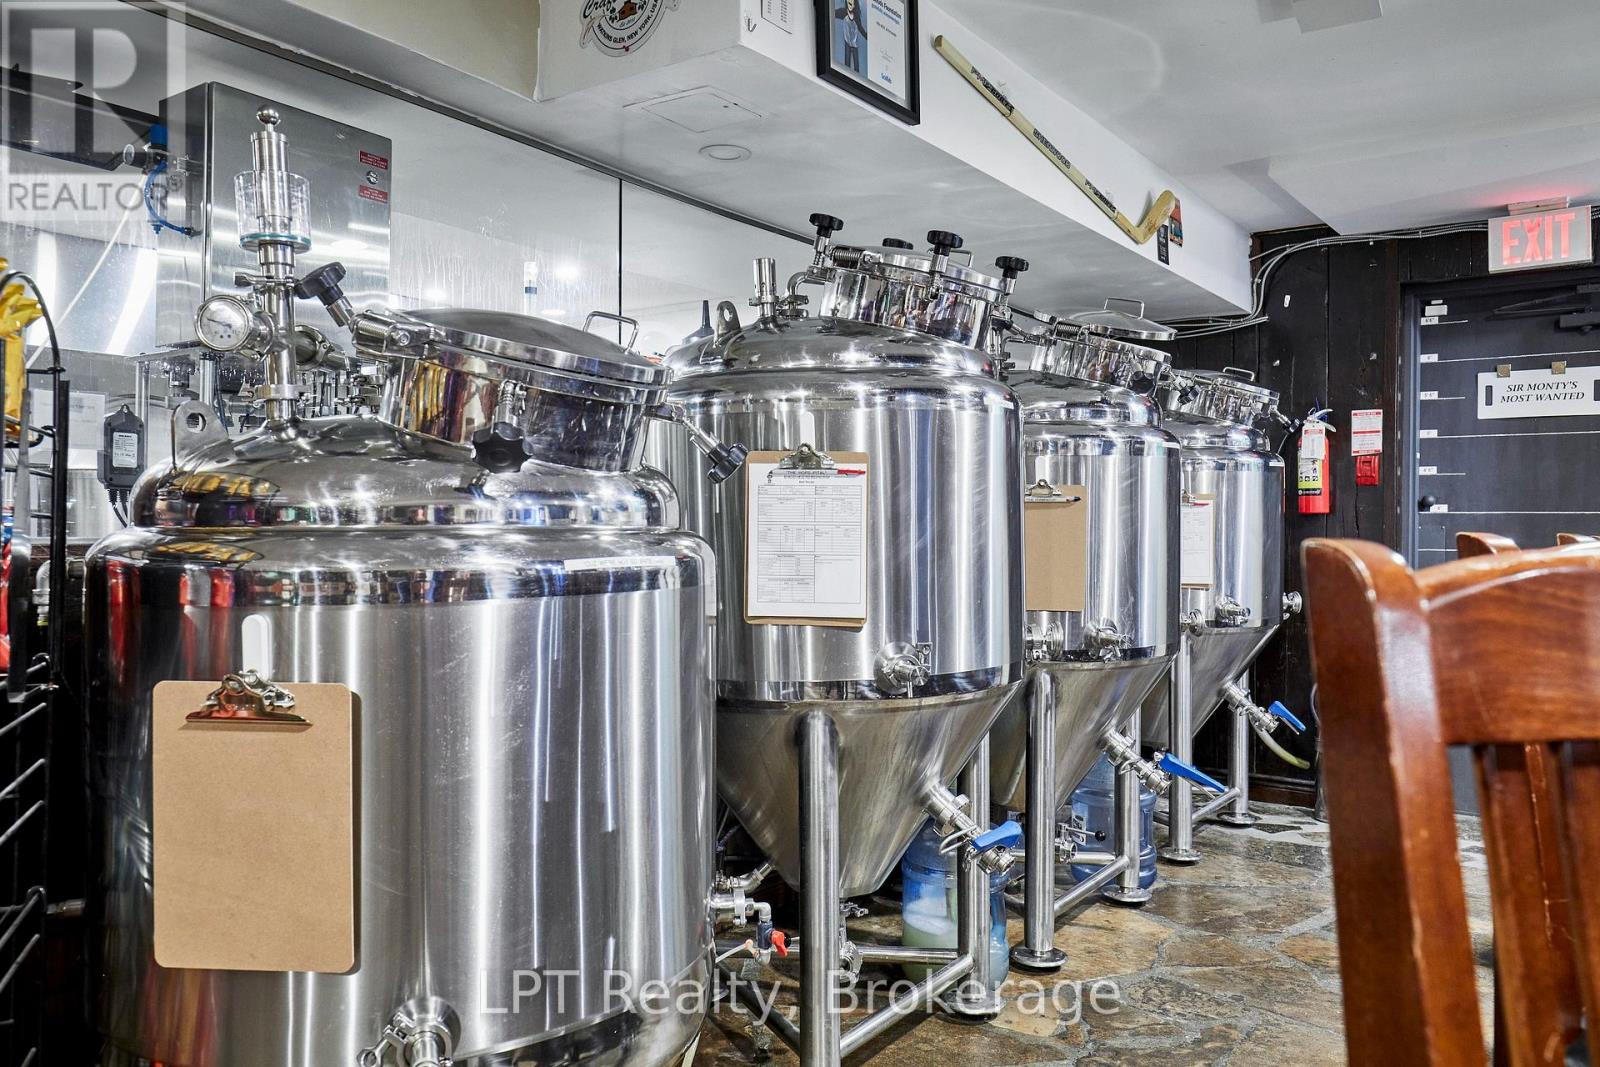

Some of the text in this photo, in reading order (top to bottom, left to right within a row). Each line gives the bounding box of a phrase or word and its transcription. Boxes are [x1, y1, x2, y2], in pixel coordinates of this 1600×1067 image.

[626, 29, 639, 41] NEW
[1502, 212, 1576, 266] EXIT
[1506, 380, 1578, 393] SIR MONTY'S
[1500, 392, 1585, 403] MOST WANTED
